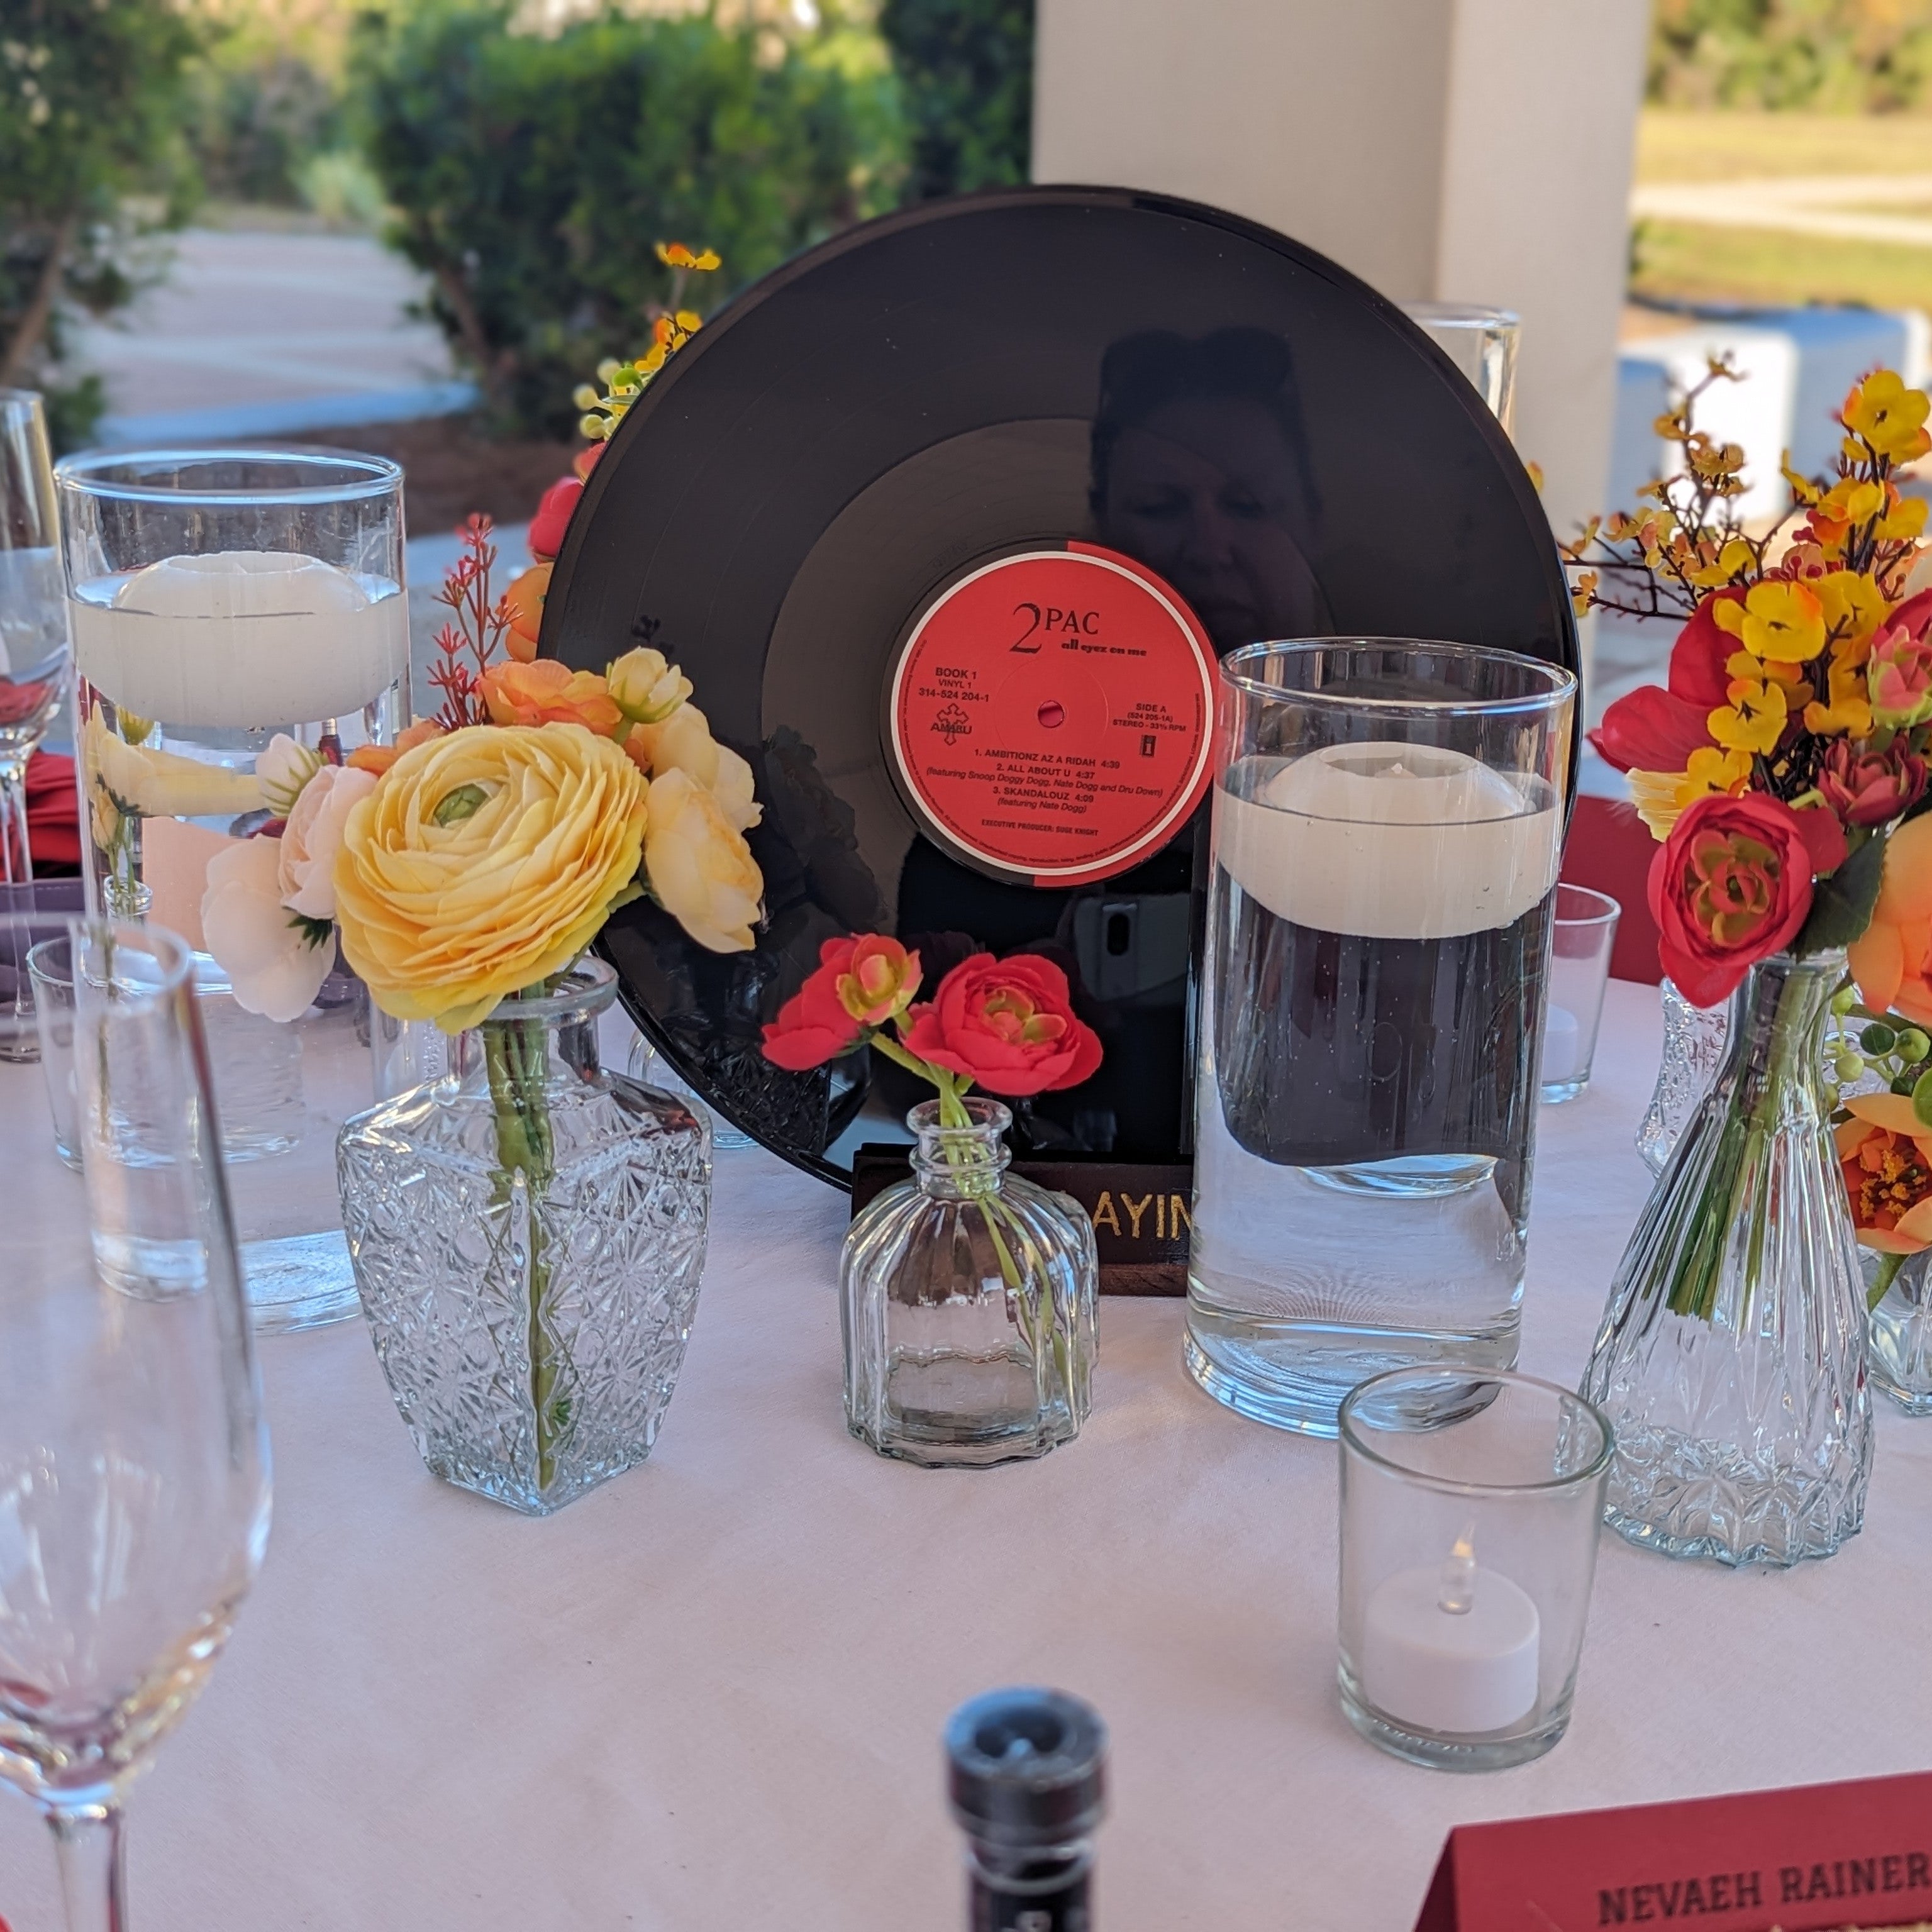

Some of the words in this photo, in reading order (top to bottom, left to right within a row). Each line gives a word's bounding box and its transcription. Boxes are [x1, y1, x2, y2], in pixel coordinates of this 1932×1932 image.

[1009, 602, 1099, 654] 2PAC
[1061, 638, 1079, 650] all
[1080, 643, 1107, 653] eyez
[1128, 648, 1146, 657] me
[935, 667, 969, 679] BOOK
[972, 671, 977, 679] 1
[939, 679, 965, 689] VINYL
[919, 687, 958, 699] 314-524
[962, 691, 989, 702] 204-1
[1136, 703, 1158, 712] SIDE
[1113, 719, 1144, 728] STEREO
[1169, 724, 1187, 732] RPM
[985, 750, 1039, 762] AMBITIONZ
[1065, 757, 1096, 767] RIDAH
[1101, 760, 1120, 769] 4:39
[1007, 764, 1024, 773] ALL
[1028, 766, 1061, 776] ABOUT
[1075, 771, 1095, 779] 4:37
[926, 767, 966, 780] (featuring
[968, 771, 996, 782] Snoop
[997, 774, 1024, 785] Doggy
[1053, 779, 1074, 788] Nate
[1075, 780, 1098, 792] Dogg
[1118, 785, 1134, 794] Dru
[1135, 786, 1163, 799] Down)
[992, 786, 1001, 794] 3.
[1004, 787, 1070, 800] SKANDALOUZ
[1075, 794, 1094, 802] 4:09
[997, 797, 1038, 809] (featuring
[1040, 801, 1059, 810] Nate
[1061, 802, 1087, 814] Dogg)
[982, 819, 1016, 829] EXECUTIVE
[1018, 823, 1054, 833] PRODUCER:
[1074, 828, 1099, 836] KNIGHT
[1598, 1871, 1762, 1926] NEVAEH
